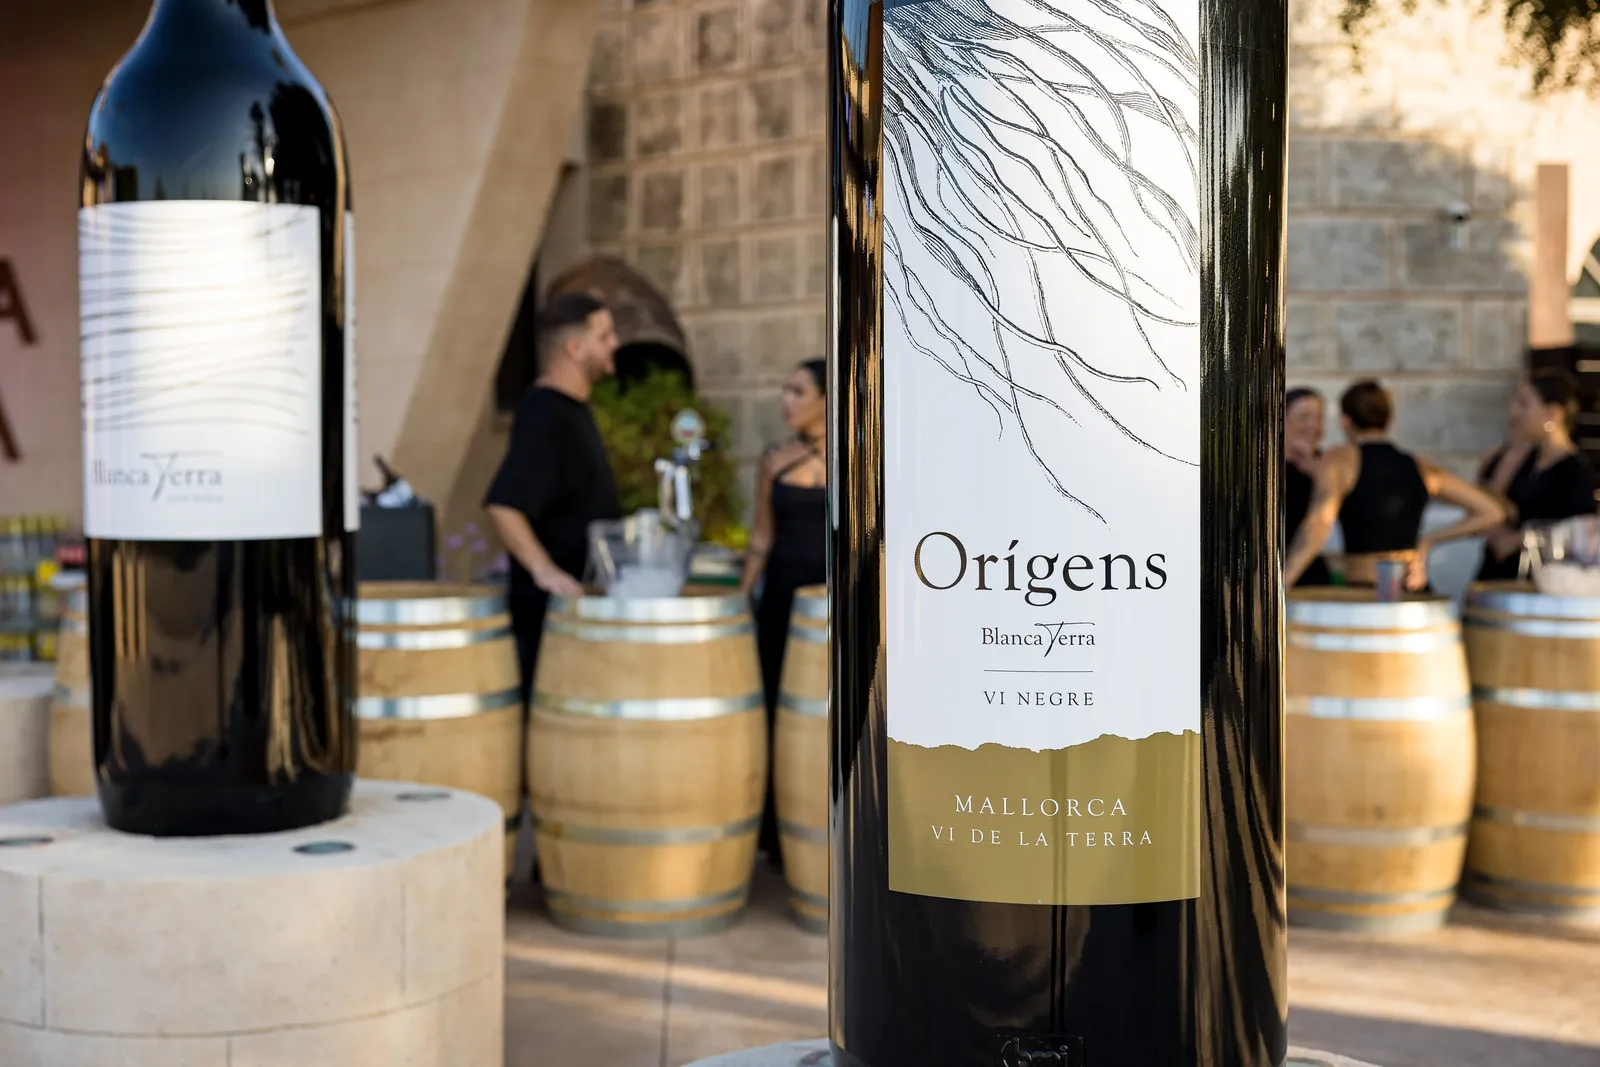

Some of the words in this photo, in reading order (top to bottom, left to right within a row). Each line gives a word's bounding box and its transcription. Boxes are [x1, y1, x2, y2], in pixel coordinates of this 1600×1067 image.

[913, 531, 1168, 607] Orígens
[983, 691, 1005, 706] VI
[1017, 692, 1094, 706] NEGRE
[954, 794, 1128, 817] MALLORCA
[931, 825, 954, 842] VI
[971, 829, 1001, 845] DE
[1019, 831, 1049, 847] LA
[1066, 830, 1153, 847] TERRA
